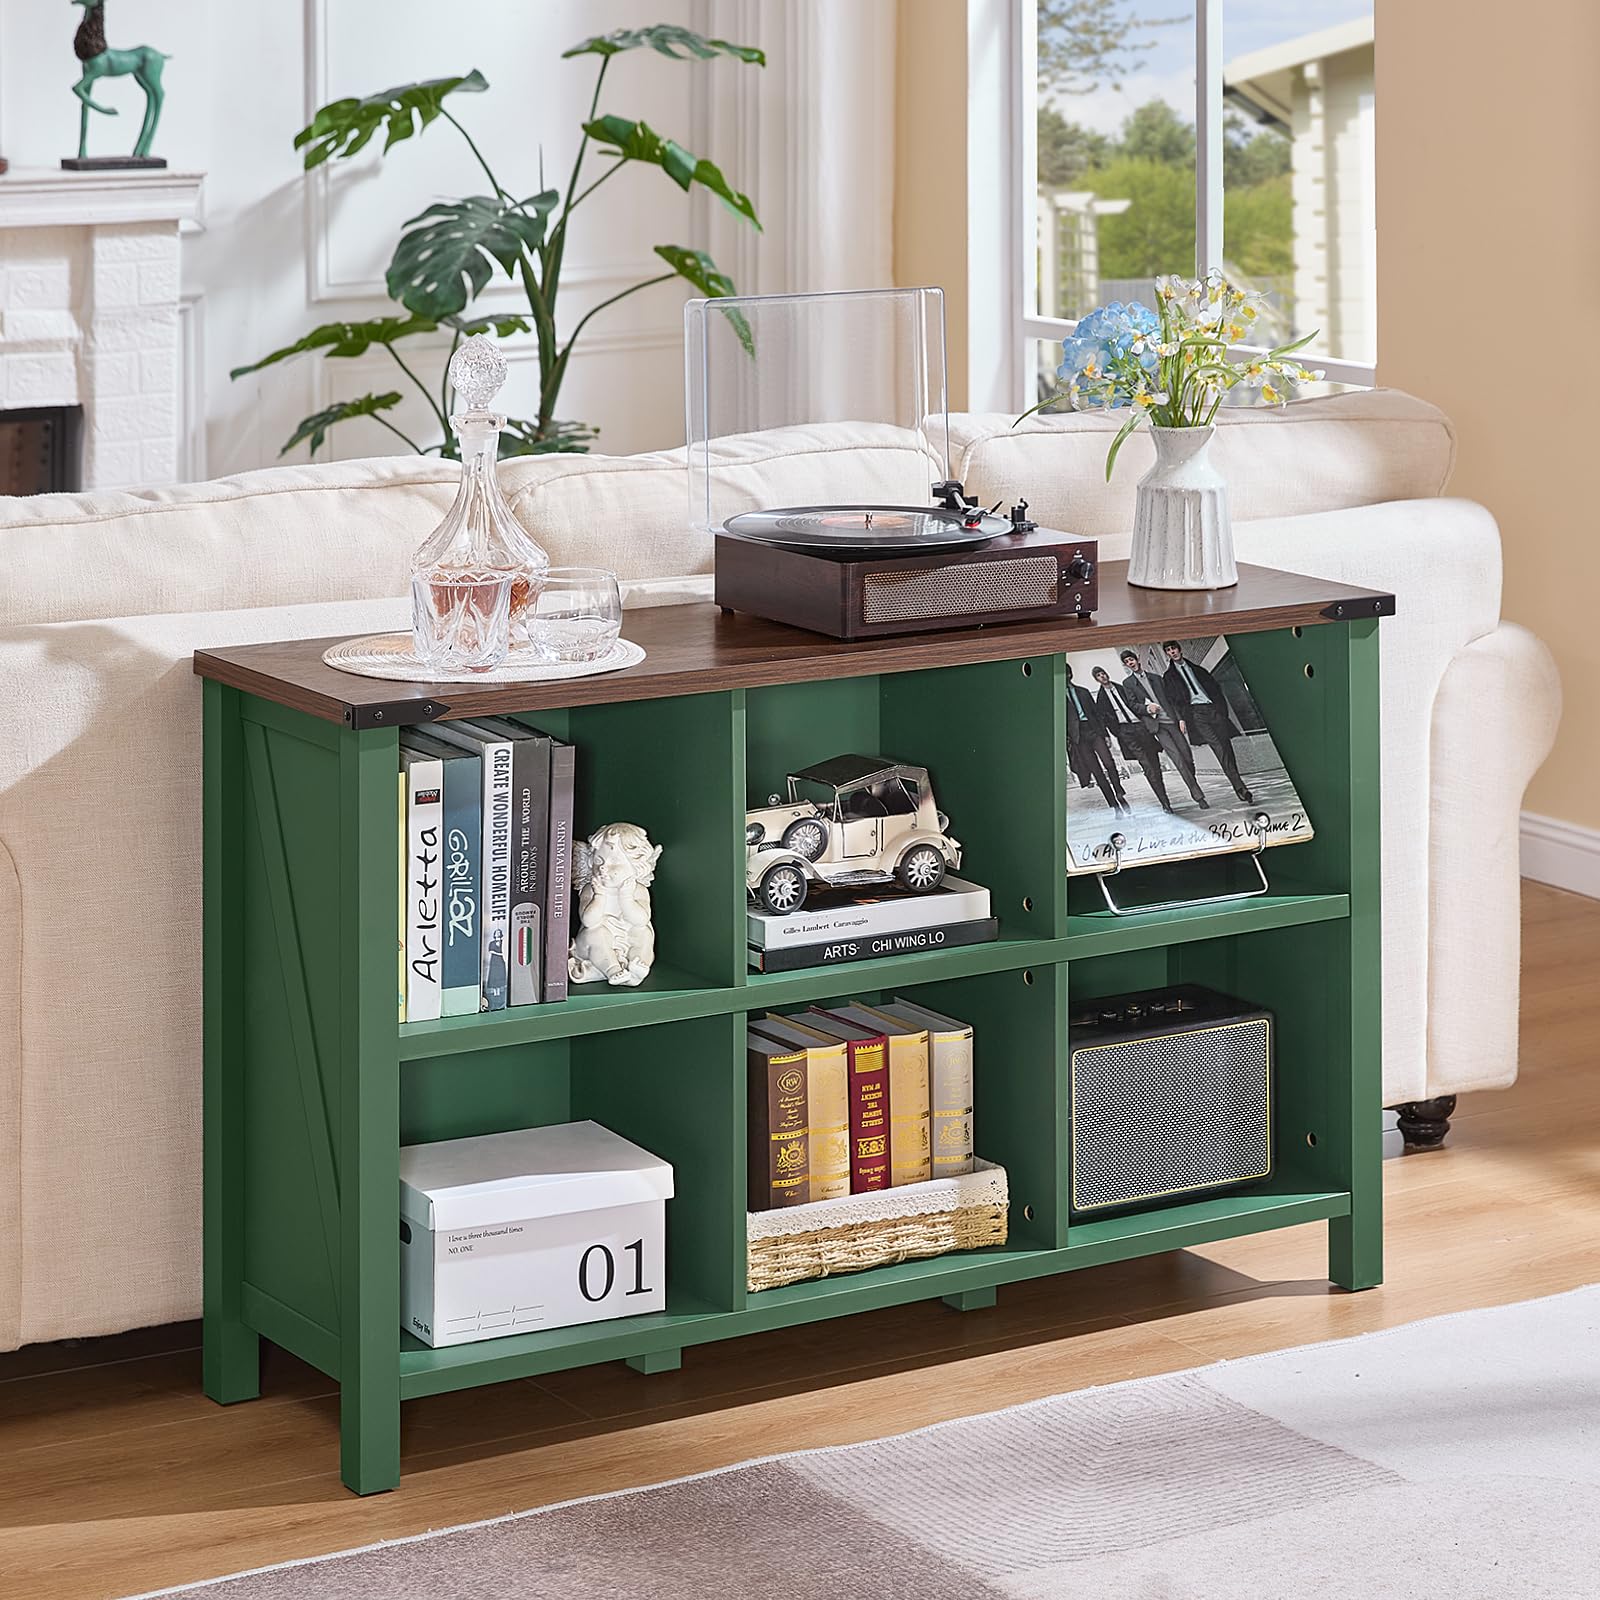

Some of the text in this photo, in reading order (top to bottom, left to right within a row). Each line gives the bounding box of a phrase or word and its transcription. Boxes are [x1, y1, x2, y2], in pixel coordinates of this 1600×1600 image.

[491, 748, 511, 922] CREATE WONDERFUL HOMELIFE
[520, 788, 532, 893] AROUND THE WORLD
[1208, 822, 1243, 842] BBC
[1243, 819, 1290, 837] Voume
[529, 846, 538, 892] IN 80 DAYS
[552, 820, 567, 919] MINIMALIST LIFE
[783, 917, 869, 935] Gilles Lambert Caravaggio
[871, 939, 893, 952] CHI
[894, 933, 927, 949] WING
[928, 931, 945, 944] LO
[460, 1244, 474, 1253] ONE
[468, 1231, 482, 1240] three
[482, 1226, 508, 1238] thousand
[508, 1226, 523, 1234] times
[578, 1237, 653, 1302] 01
